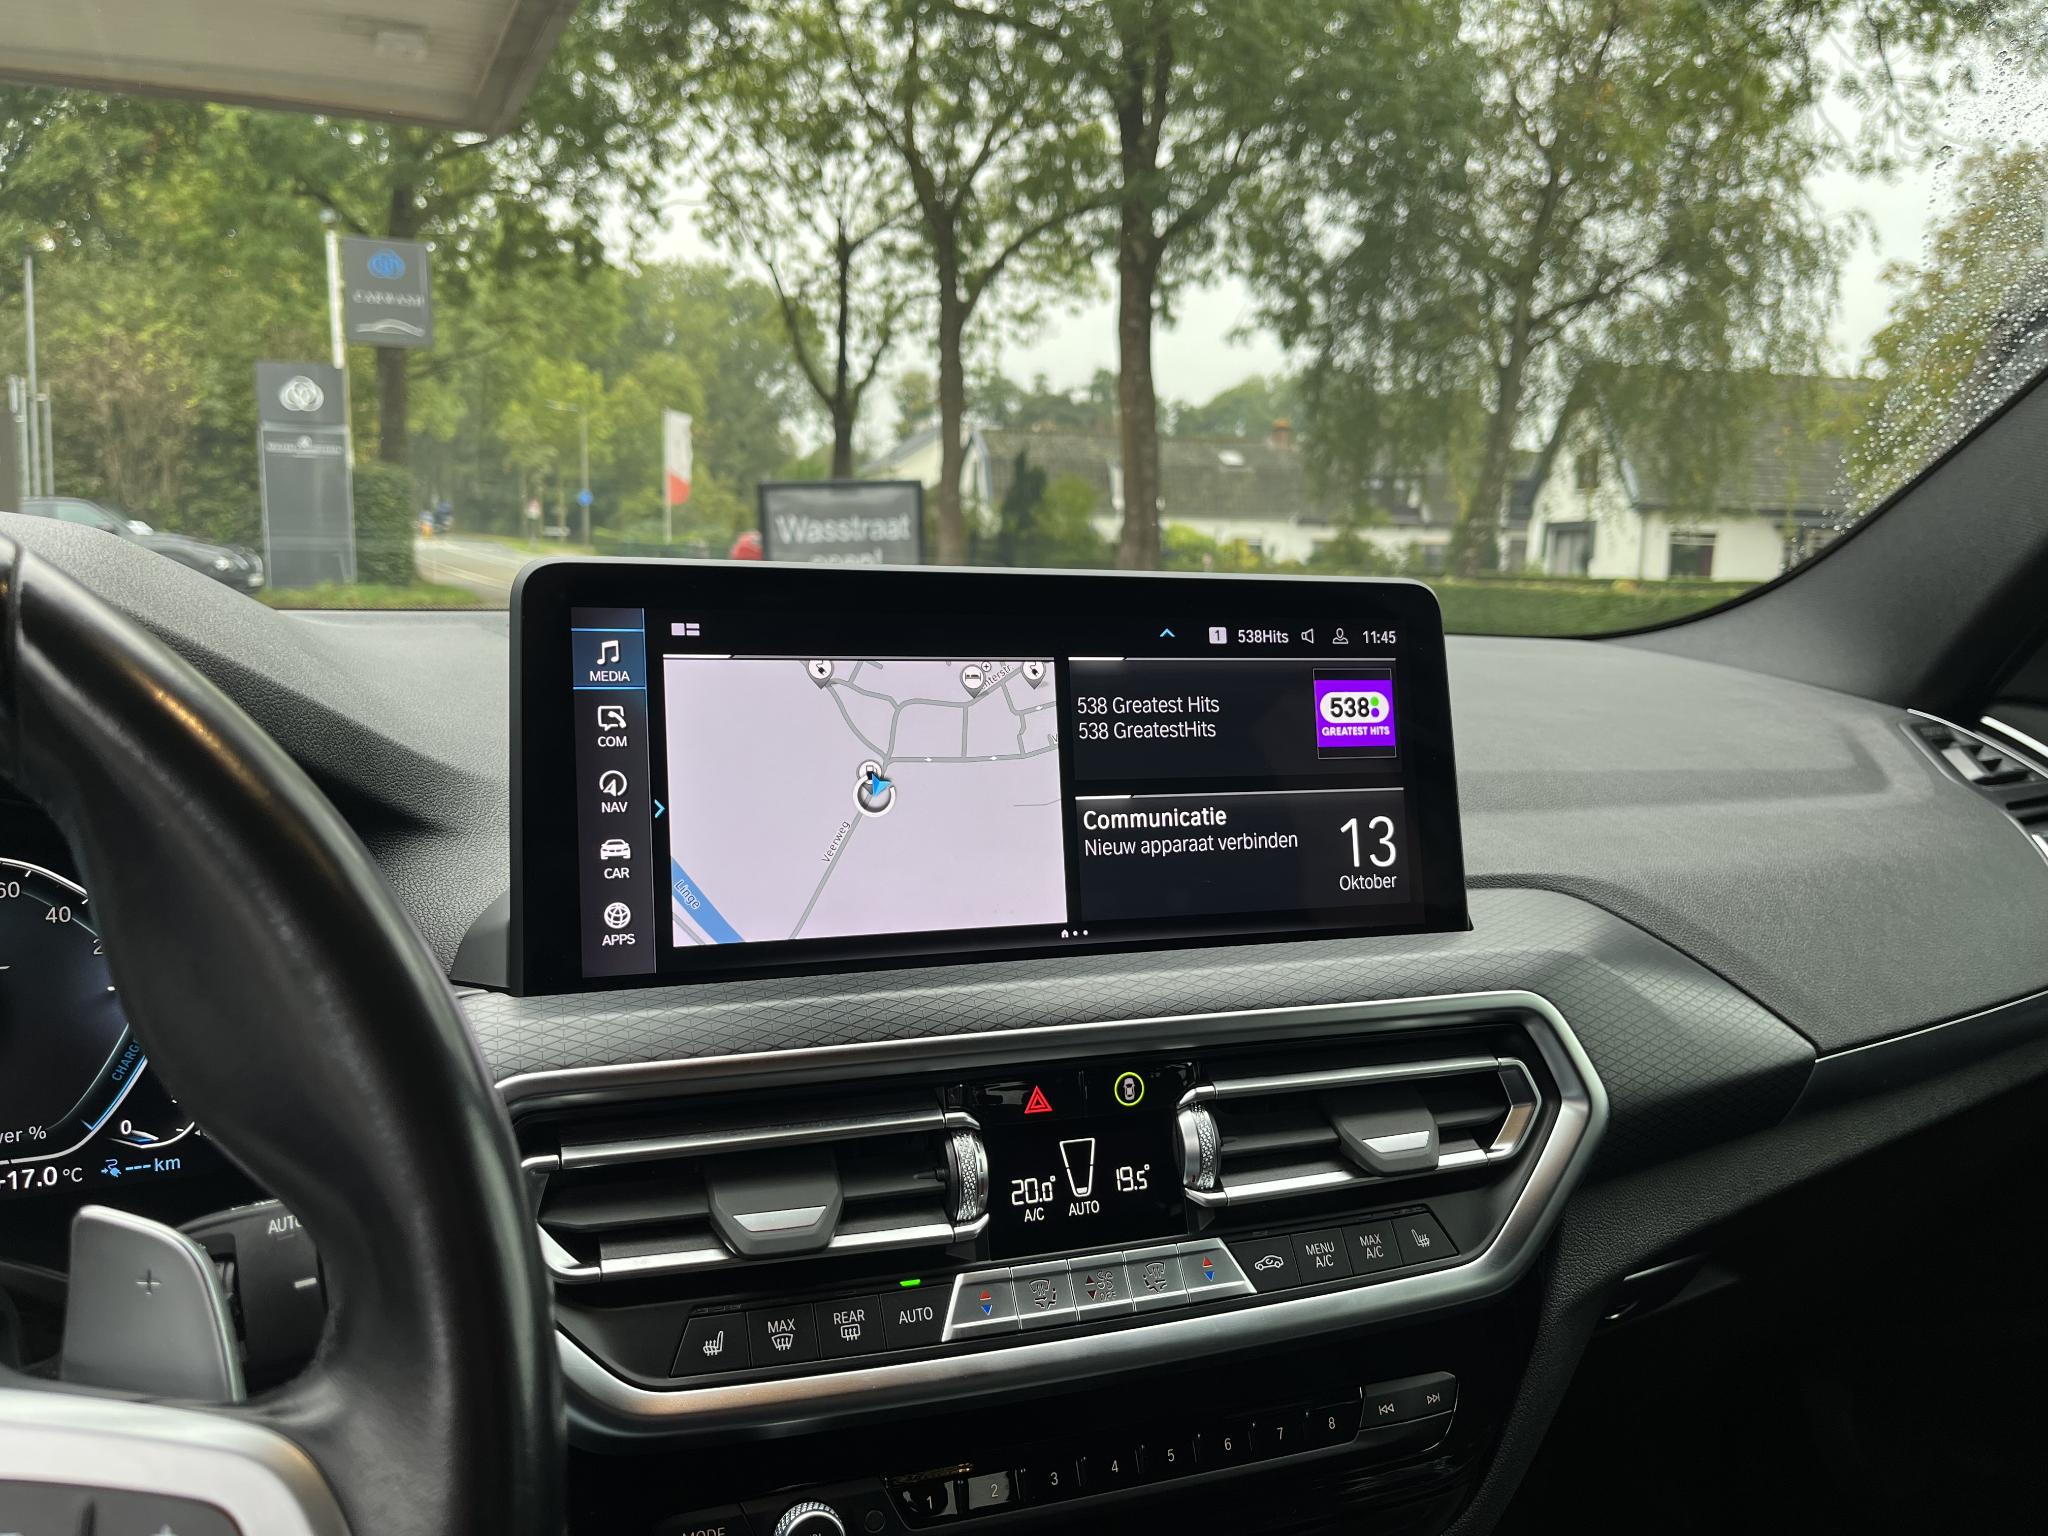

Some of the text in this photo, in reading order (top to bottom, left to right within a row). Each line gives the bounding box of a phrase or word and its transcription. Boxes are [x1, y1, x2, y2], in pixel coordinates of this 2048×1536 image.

[775, 514, 911, 544] Wasstraat
[1238, 629, 1289, 644] 538Hits
[1362, 630, 1396, 644] 11:45
[589, 670, 630, 682] MEDIA
[1077, 695, 1220, 714] 538 Greatest Hits
[1078, 722, 1109, 740] 538
[1113, 721, 1217, 739] GreatestHits
[1321, 726, 1390, 736] GREATEST HITS
[598, 736, 627, 747] COM
[601, 801, 628, 813] NAV
[1083, 807, 1227, 830] Communicatie
[822, 820, 851, 863] Veerweg
[1084, 832, 1299, 857] Nieuw apparaat verbinden
[1340, 815, 1397, 868] 13
[604, 867, 630, 879] CAR
[0, 881, 21, 899] 60
[1339, 874, 1397, 891] Oktober
[674, 879, 701, 911] Linge
[45, 906, 72, 924] 40
[602, 934, 635, 946] APPS
[111, 1040, 141, 1081] CHARG
[28, 1125, 47, 1140] %
[120, 1119, 132, 1135] 0
[154, 1157, 181, 1172] km
[62, 1167, 83, 1182] °C
[1024, 1207, 1045, 1222] A/C
[1068, 1200, 1100, 1216] AUTO
[1360, 1233, 1382, 1246] MAX
[1306, 1242, 1335, 1255] MENU
[1366, 1246, 1384, 1259] A/C
[1316, 1255, 1334, 1268] A/C
[833, 1309, 865, 1325] REAR
[899, 1306, 933, 1325] AUTO
[767, 1318, 796, 1334] MAX
[1328, 1416, 1336, 1430] 8
[1276, 1427, 1284, 1440] 7
[1224, 1438, 1232, 1451] 6
[1167, 1449, 1175, 1462] 5
[1111, 1460, 1119, 1473] 4
[1050, 1472, 1059, 1486] 3
[991, 1484, 999, 1498] 2
[926, 1496, 934, 1509] 1
